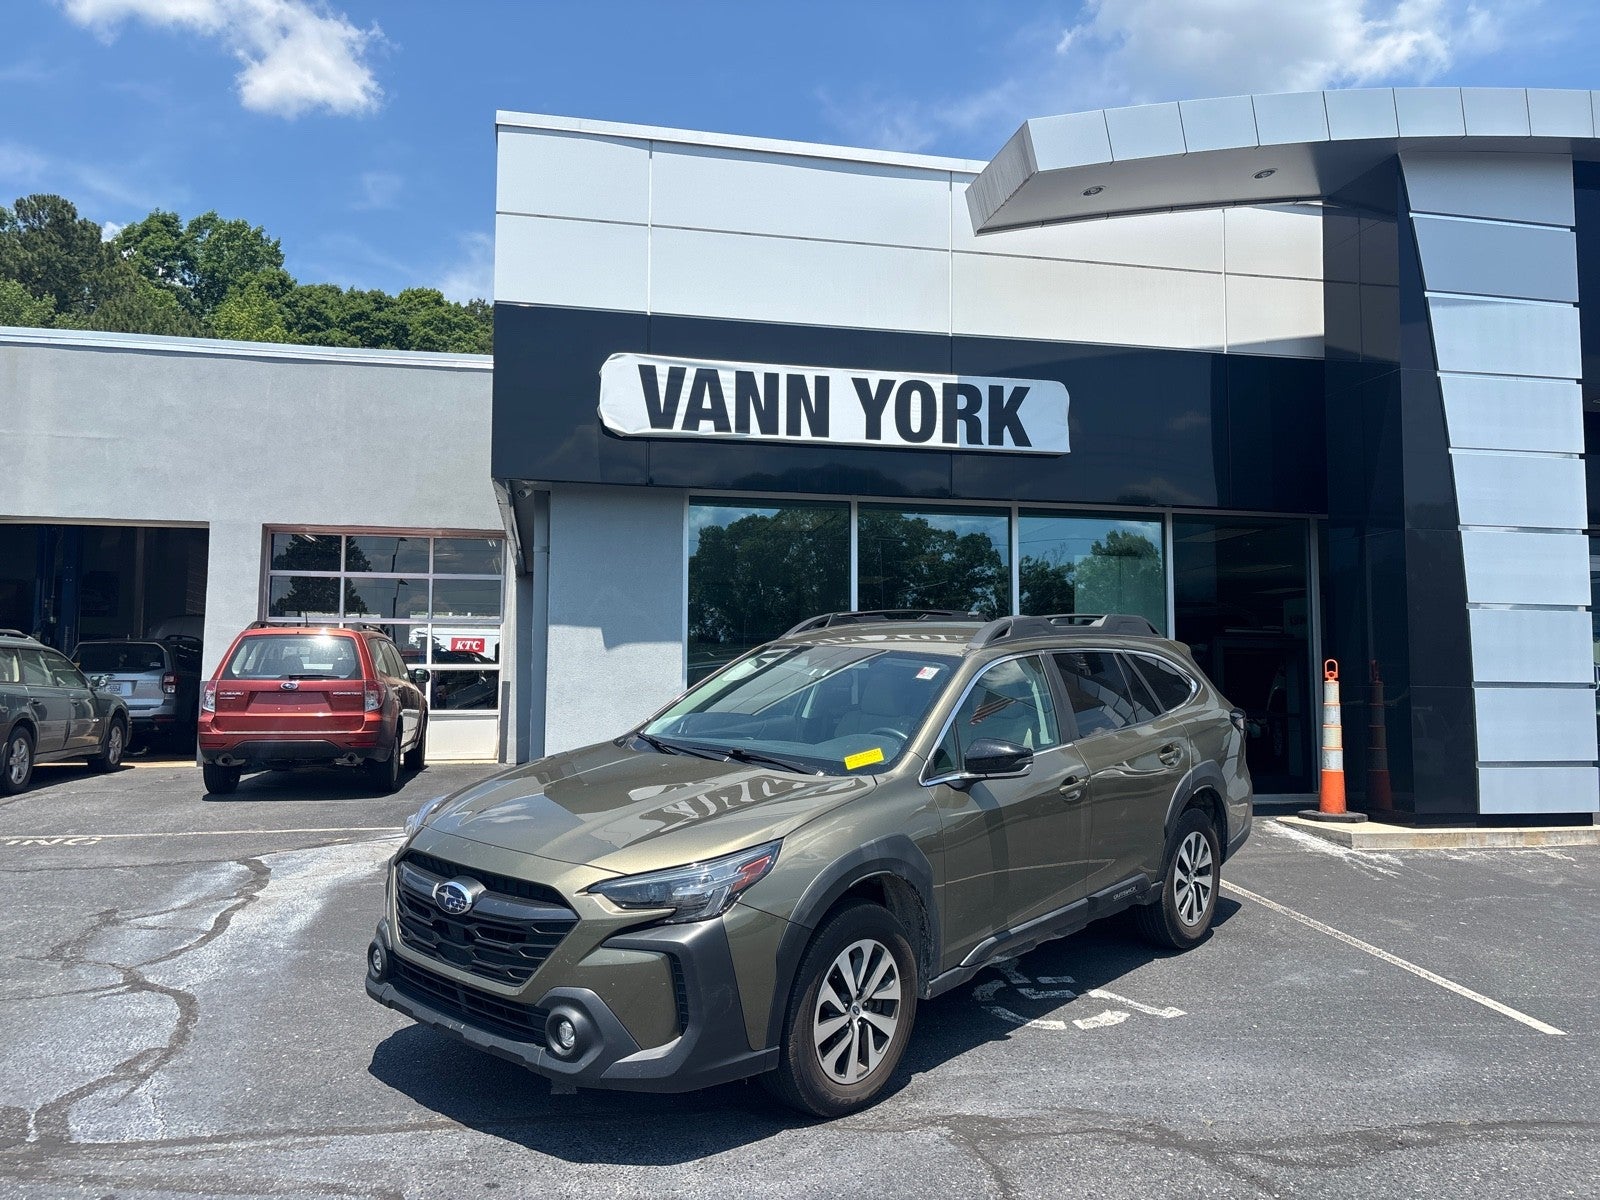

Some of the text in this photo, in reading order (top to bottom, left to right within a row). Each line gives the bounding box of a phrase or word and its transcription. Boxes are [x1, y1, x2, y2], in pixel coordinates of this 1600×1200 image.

[637, 364, 1032, 448] VANN YORK
[455, 640, 481, 650] KTC
[1113, 885, 1138, 900] OUTBACK
